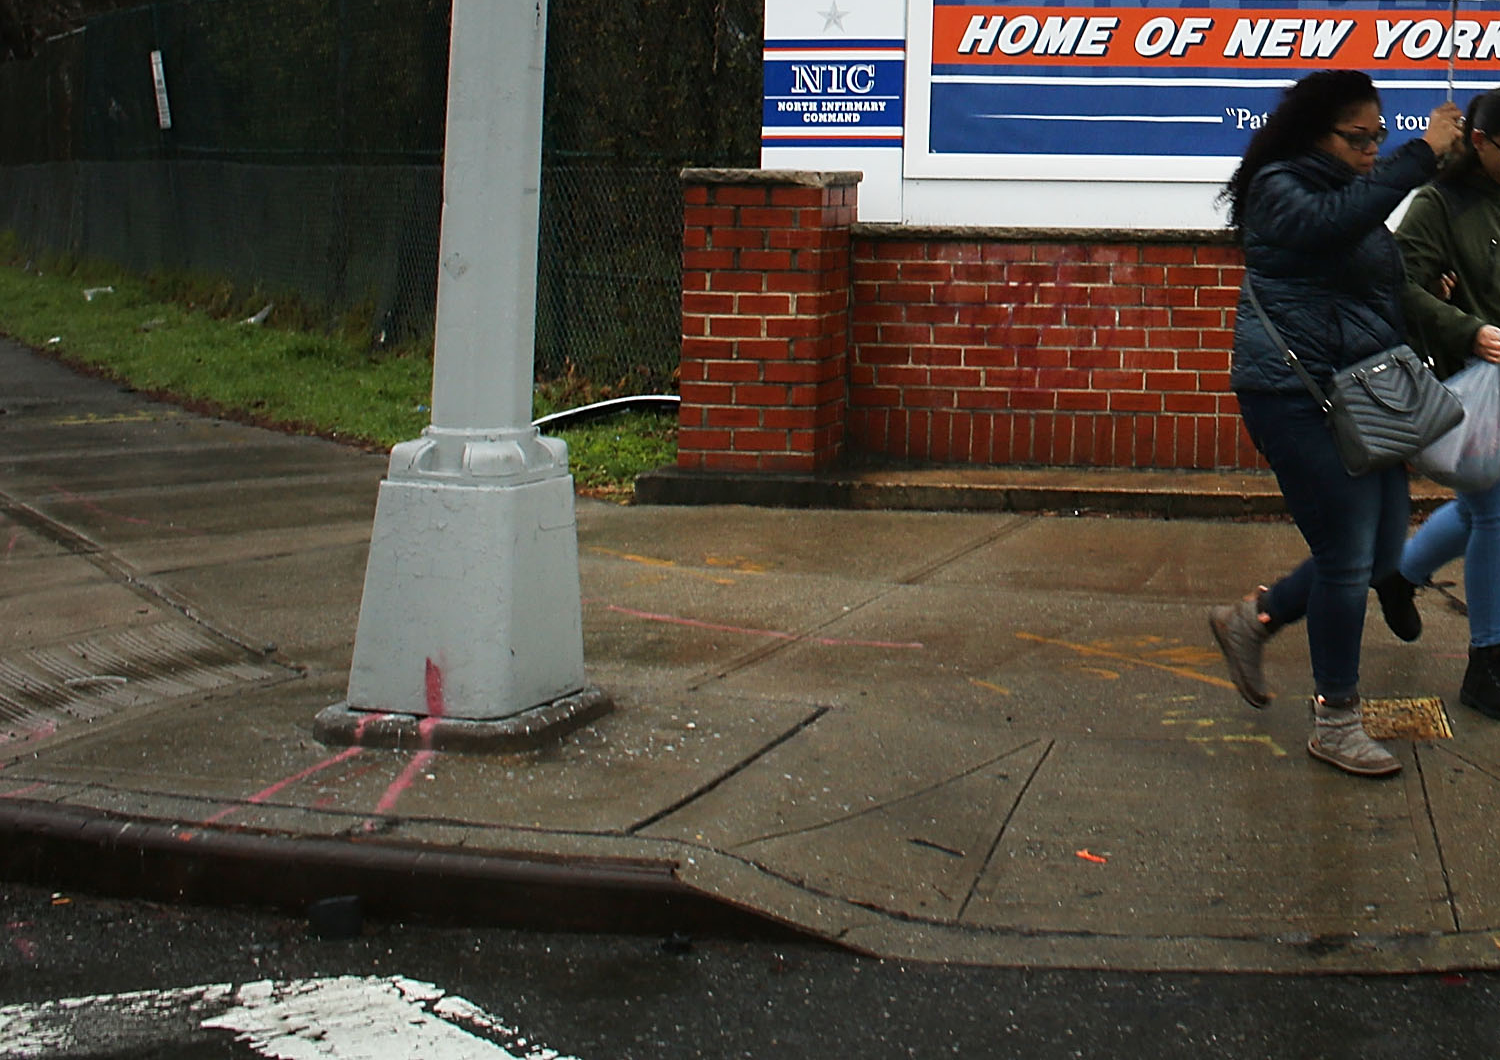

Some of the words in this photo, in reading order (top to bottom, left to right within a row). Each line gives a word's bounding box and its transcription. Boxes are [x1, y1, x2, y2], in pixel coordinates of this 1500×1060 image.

[957, 14, 1120, 57] HOME
[1134, 16, 1215, 58] OF
[1222, 17, 1356, 60] NEW
[791, 64, 875, 95] NIC
[777, 101, 820, 112] NORTH
[821, 101, 887, 112] INFIRMARY
[803, 112, 861, 123] COMMAND
